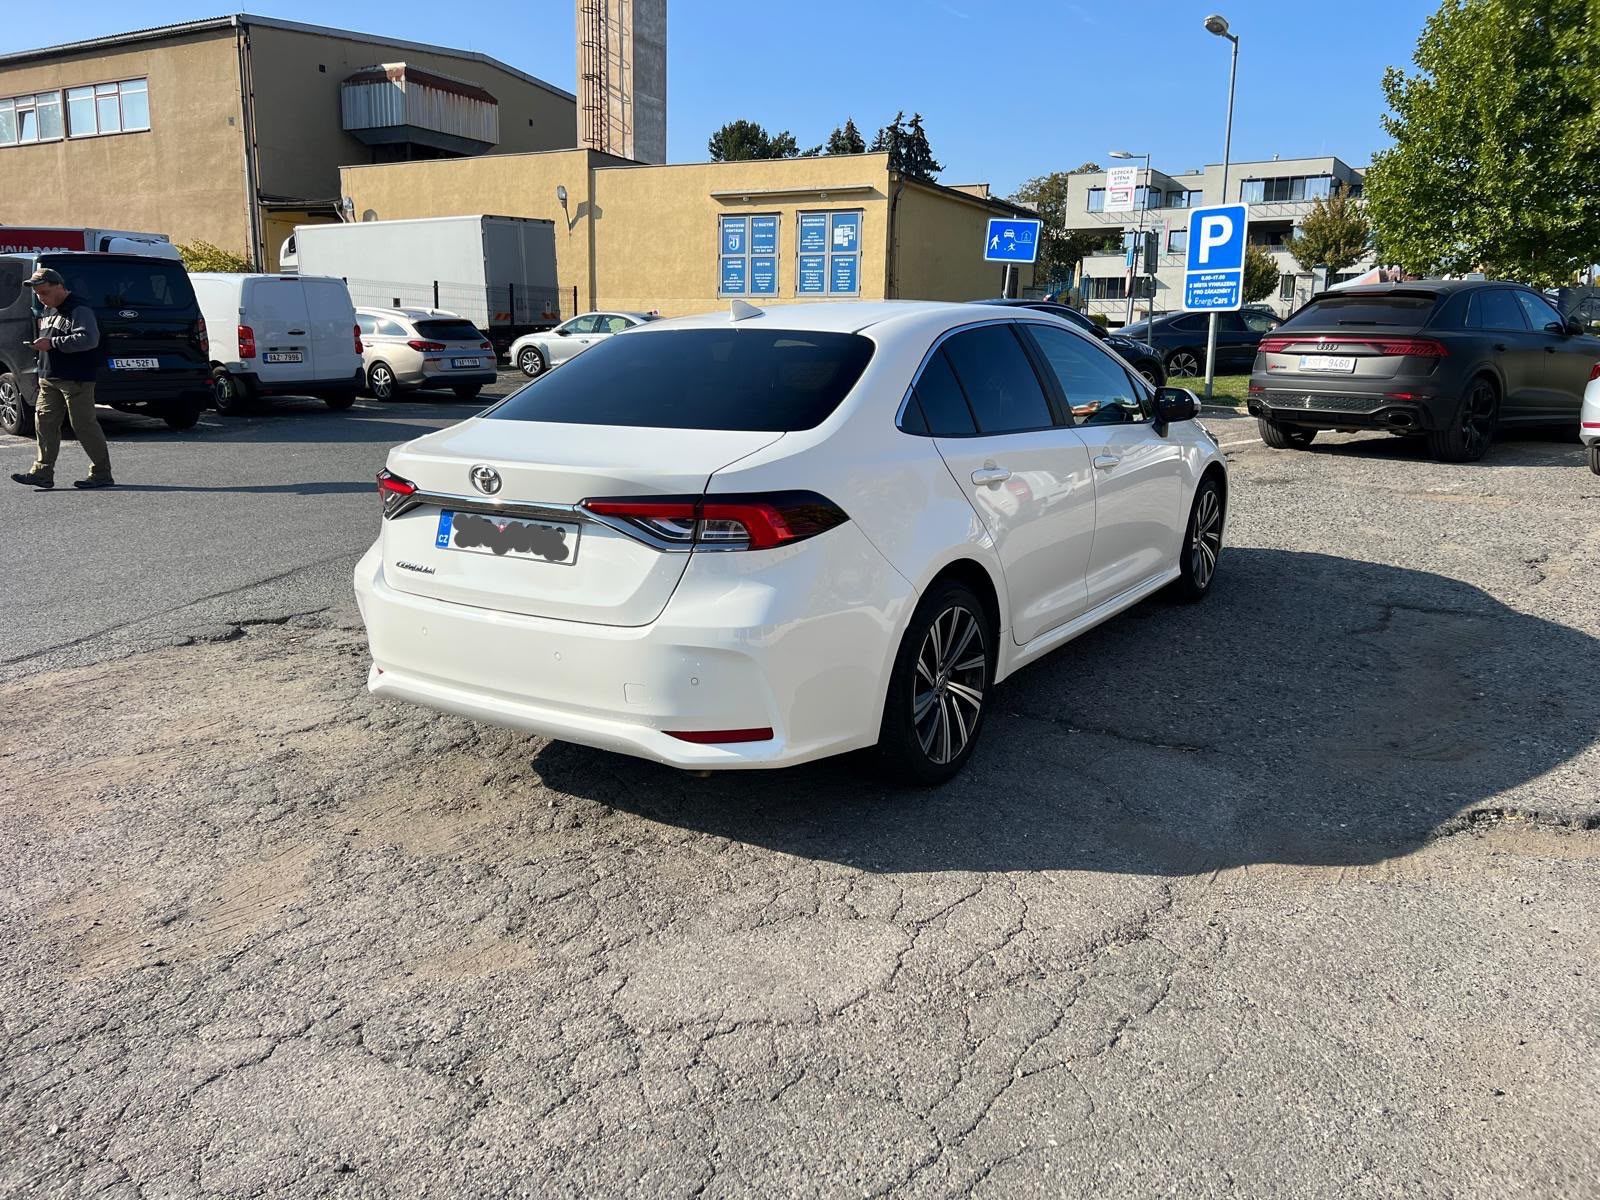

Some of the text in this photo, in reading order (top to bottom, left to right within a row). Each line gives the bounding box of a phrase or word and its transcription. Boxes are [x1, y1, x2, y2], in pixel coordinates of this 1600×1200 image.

[1198, 215, 1234, 264] P
[1194, 296, 1229, 306] EnergyCars
[1328, 358, 1351, 369] 9460
[438, 534, 449, 544] CZ
